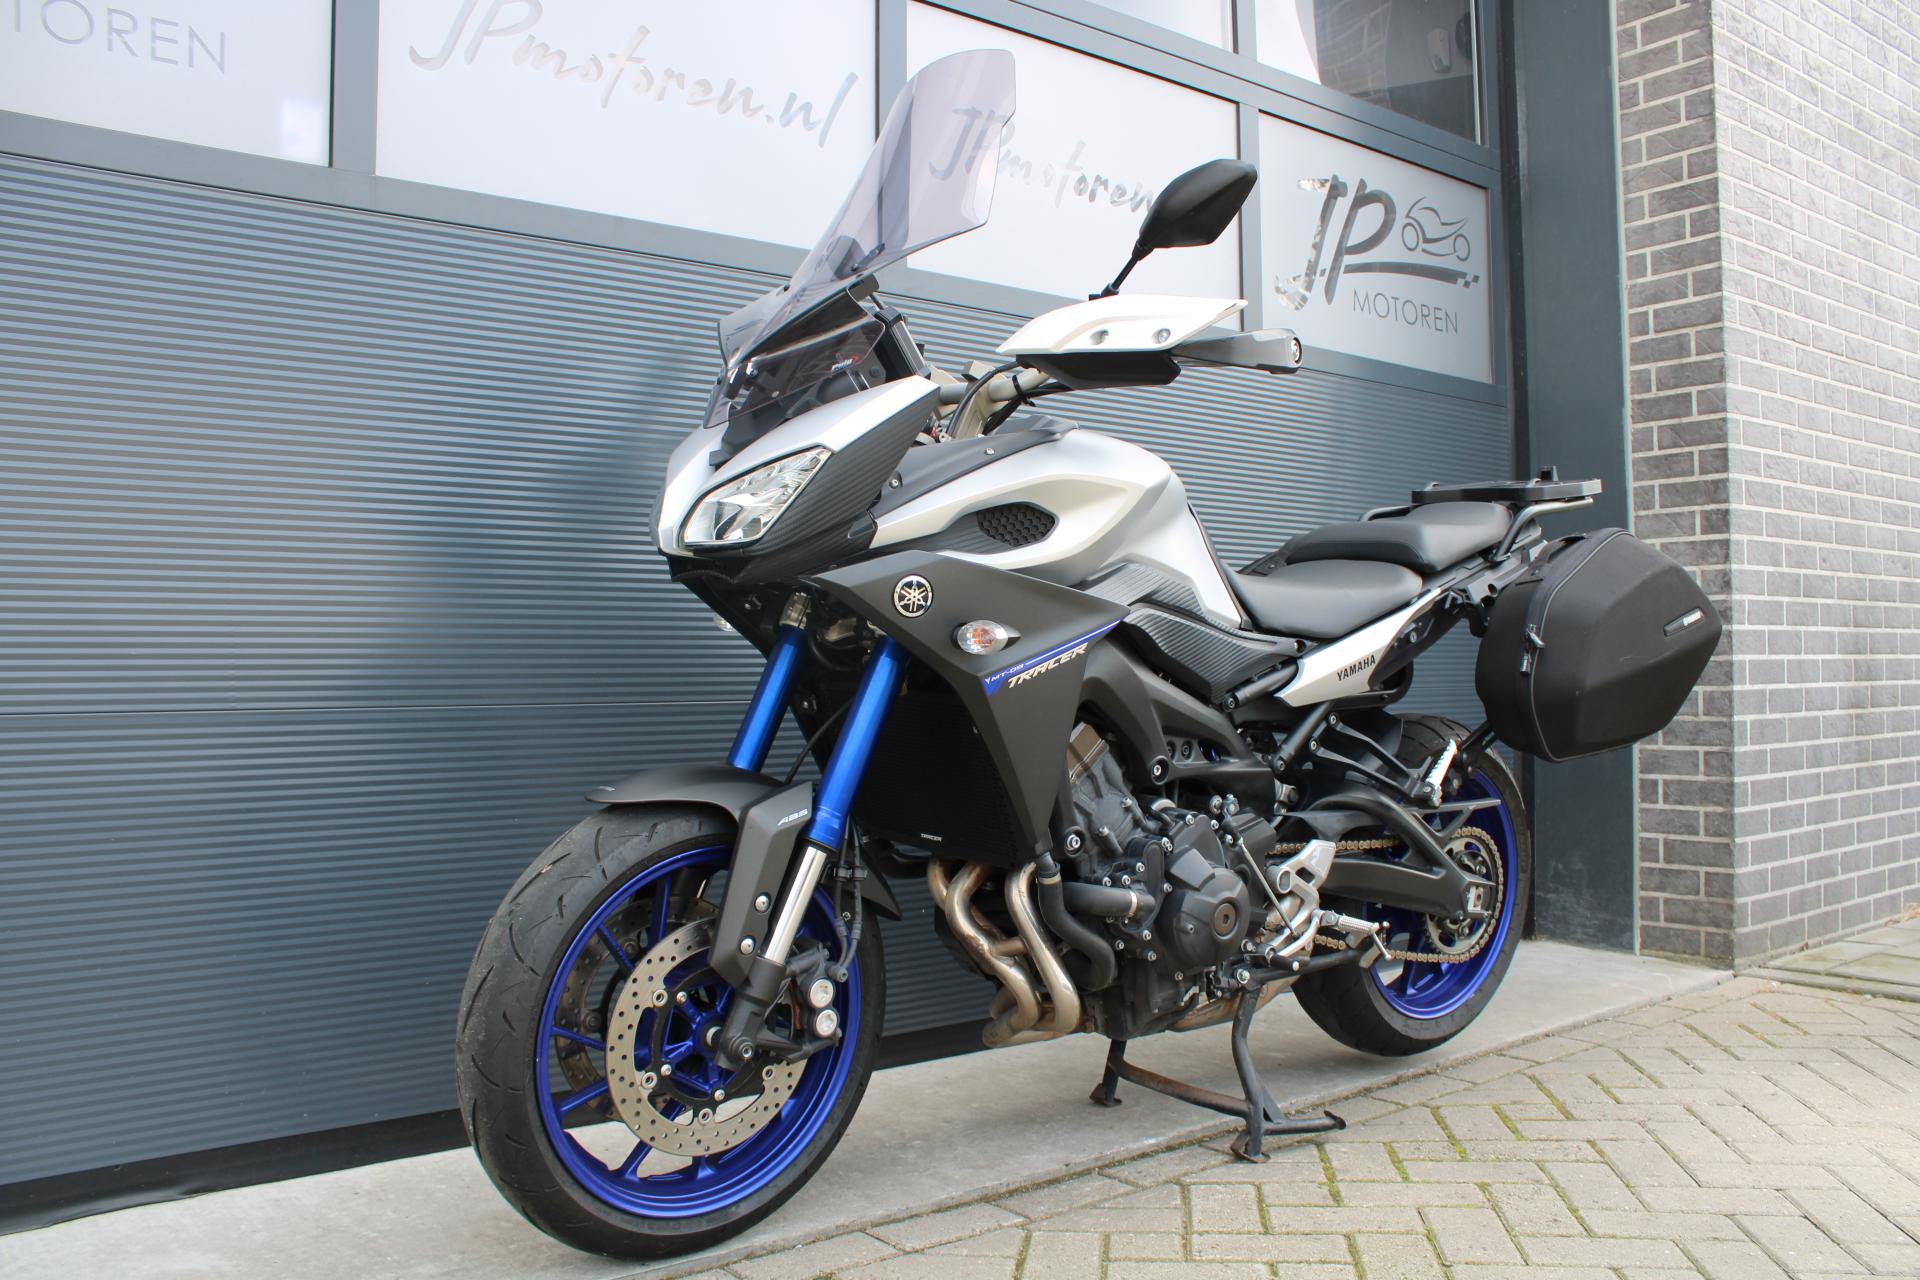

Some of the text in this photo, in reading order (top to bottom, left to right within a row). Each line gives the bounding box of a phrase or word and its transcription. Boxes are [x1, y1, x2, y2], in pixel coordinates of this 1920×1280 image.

[1352, 287, 1459, 335] MOTOREN
[1007, 642, 1089, 689] TRACER
[1336, 654, 1376, 682] YAMAHA
